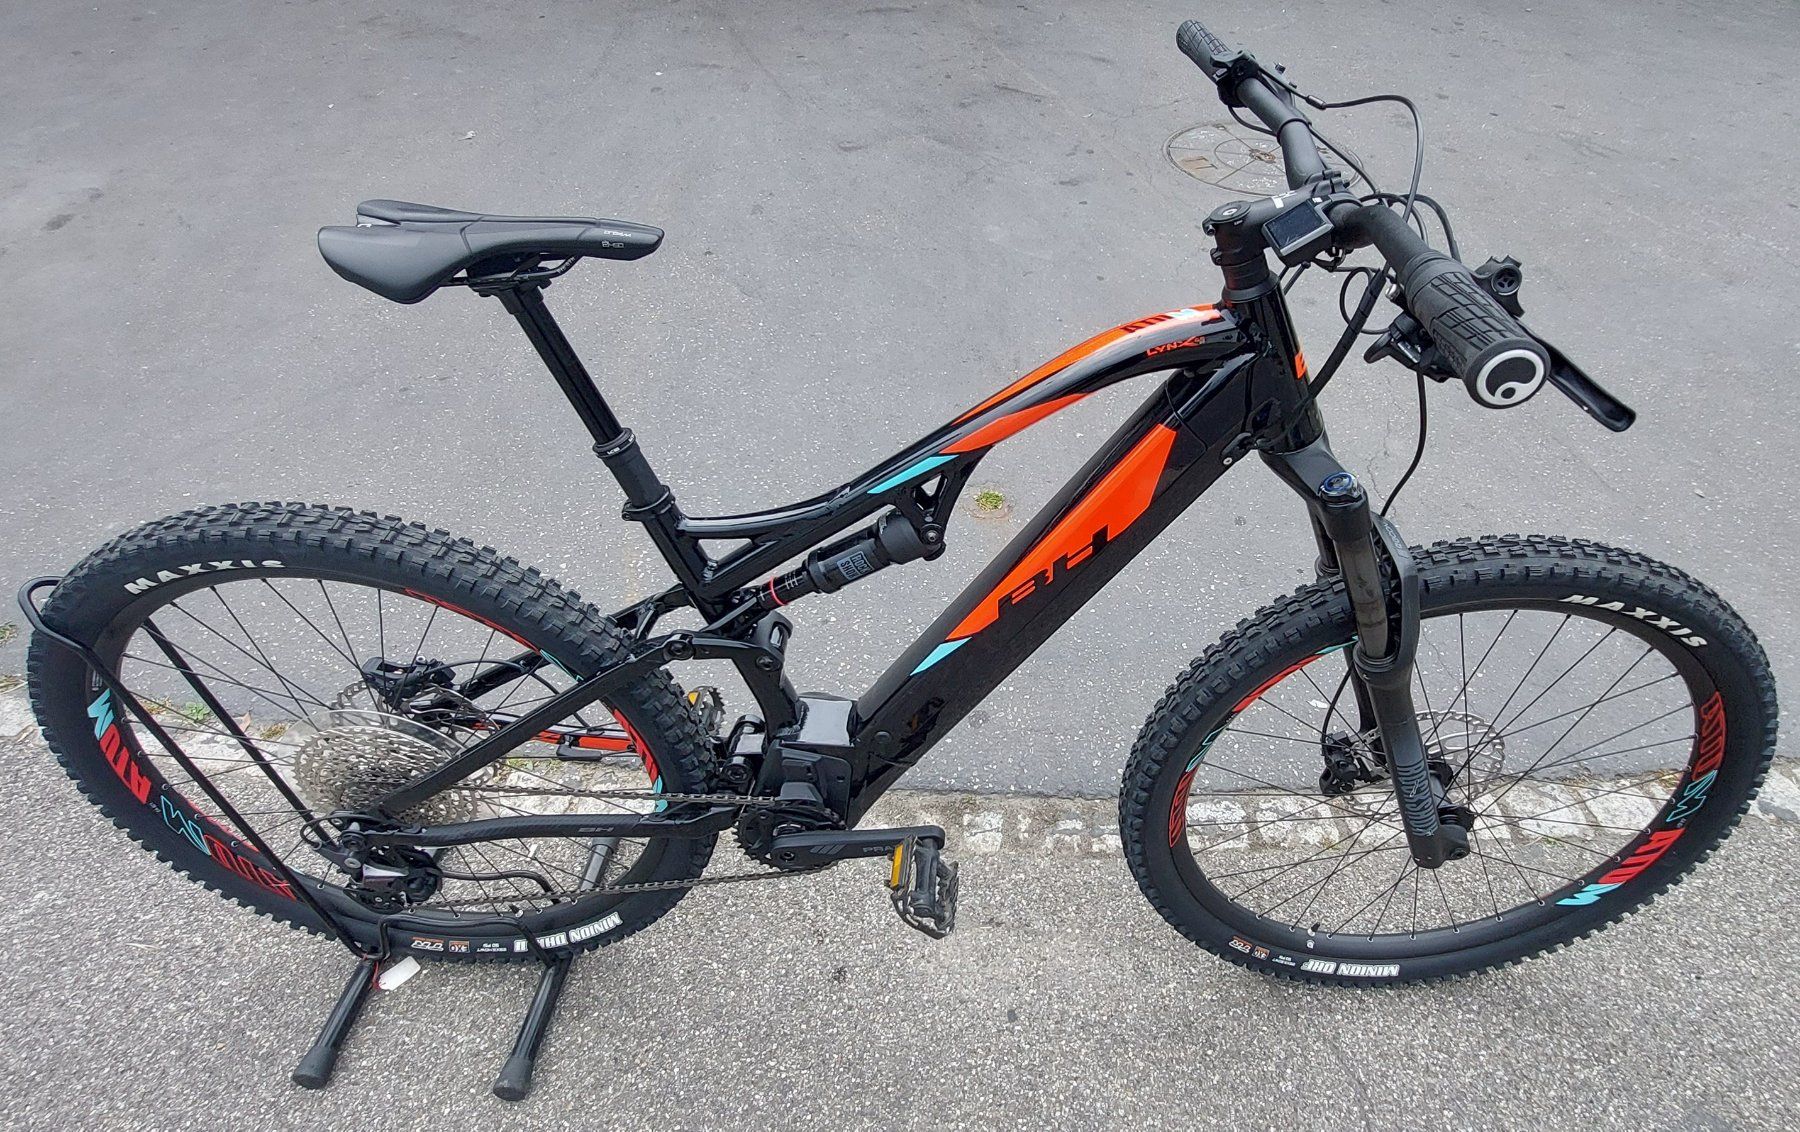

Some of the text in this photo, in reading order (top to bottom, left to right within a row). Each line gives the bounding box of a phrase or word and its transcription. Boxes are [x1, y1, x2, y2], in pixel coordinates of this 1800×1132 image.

[1146, 336, 1199, 357] LYNX
[124, 559, 286, 595] MAXXIS
[1558, 594, 1708, 647] MAXXIS
[569, 912, 623, 942] MINION
[1301, 959, 1336, 974] DHF
[1336, 963, 1401, 977] MINION
